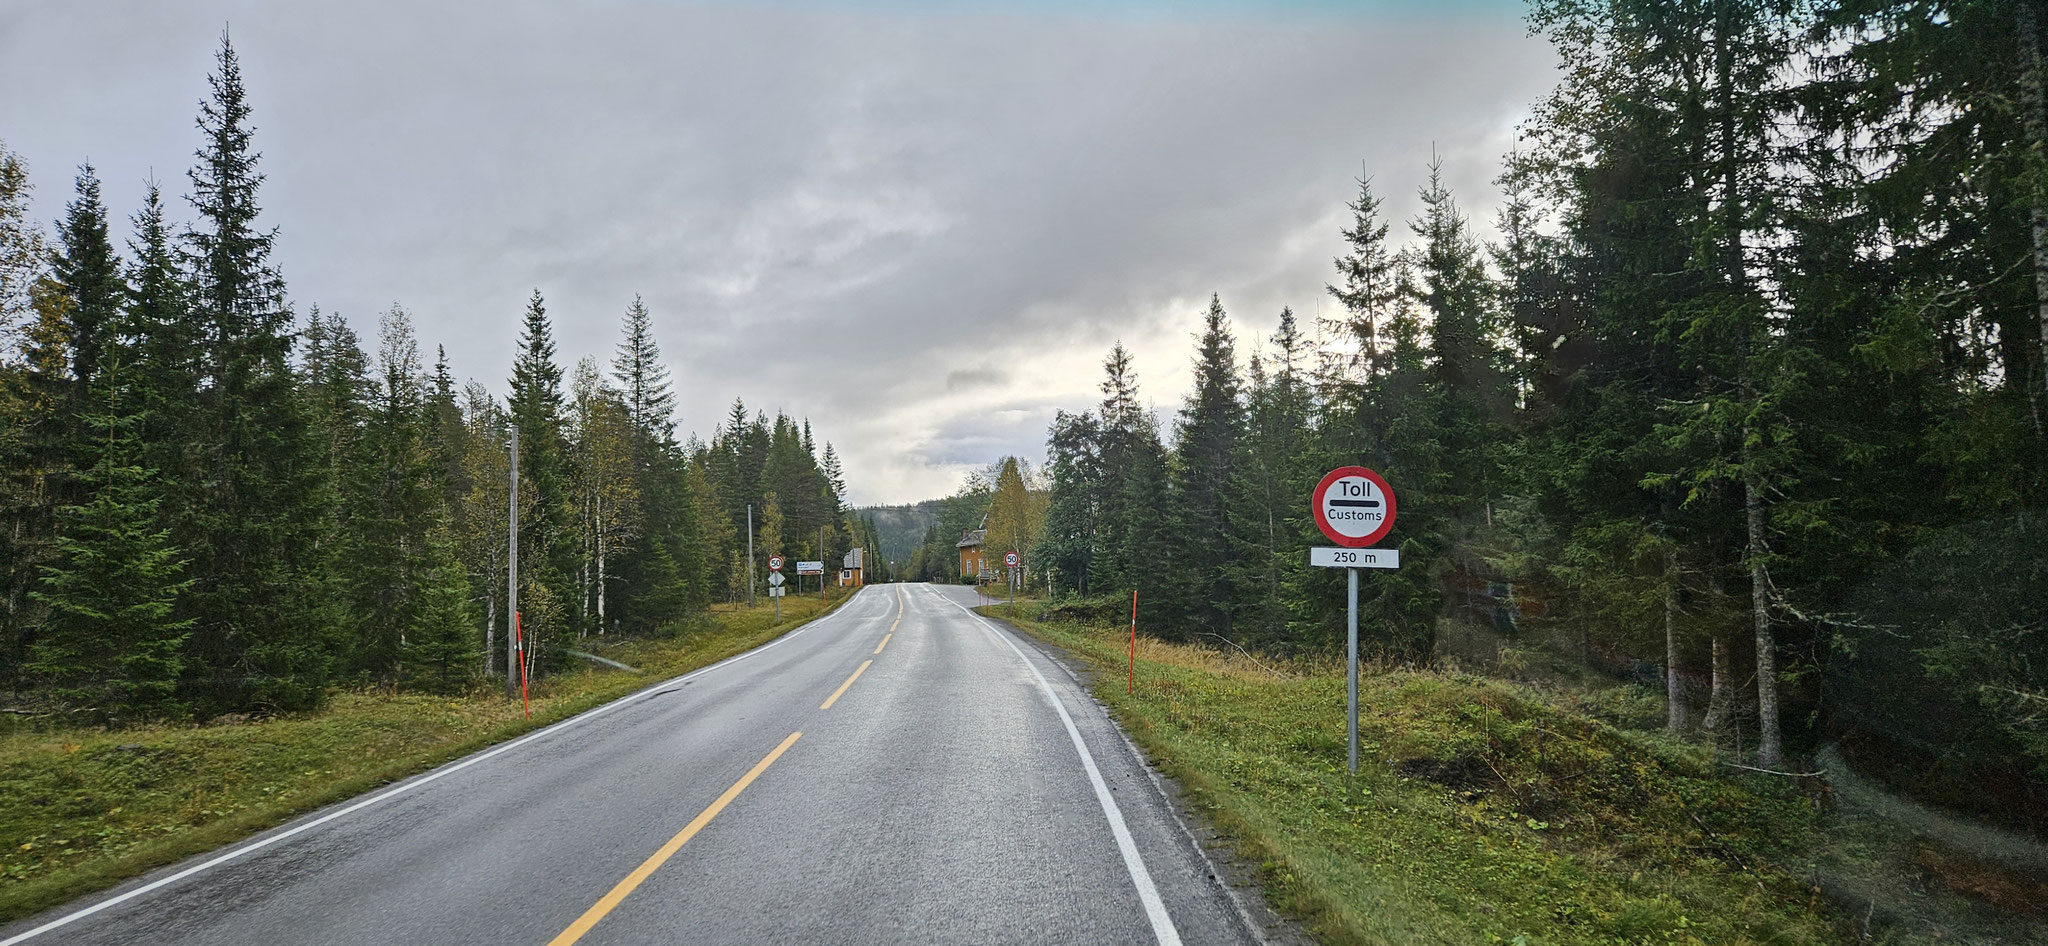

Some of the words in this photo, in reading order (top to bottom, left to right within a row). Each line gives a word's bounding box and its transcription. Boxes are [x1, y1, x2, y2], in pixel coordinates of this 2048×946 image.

[1339, 481, 1370, 497] Toll
[1328, 509, 1382, 521] Customs
[1334, 552, 1357, 563] 250
[1365, 554, 1376, 563] m
